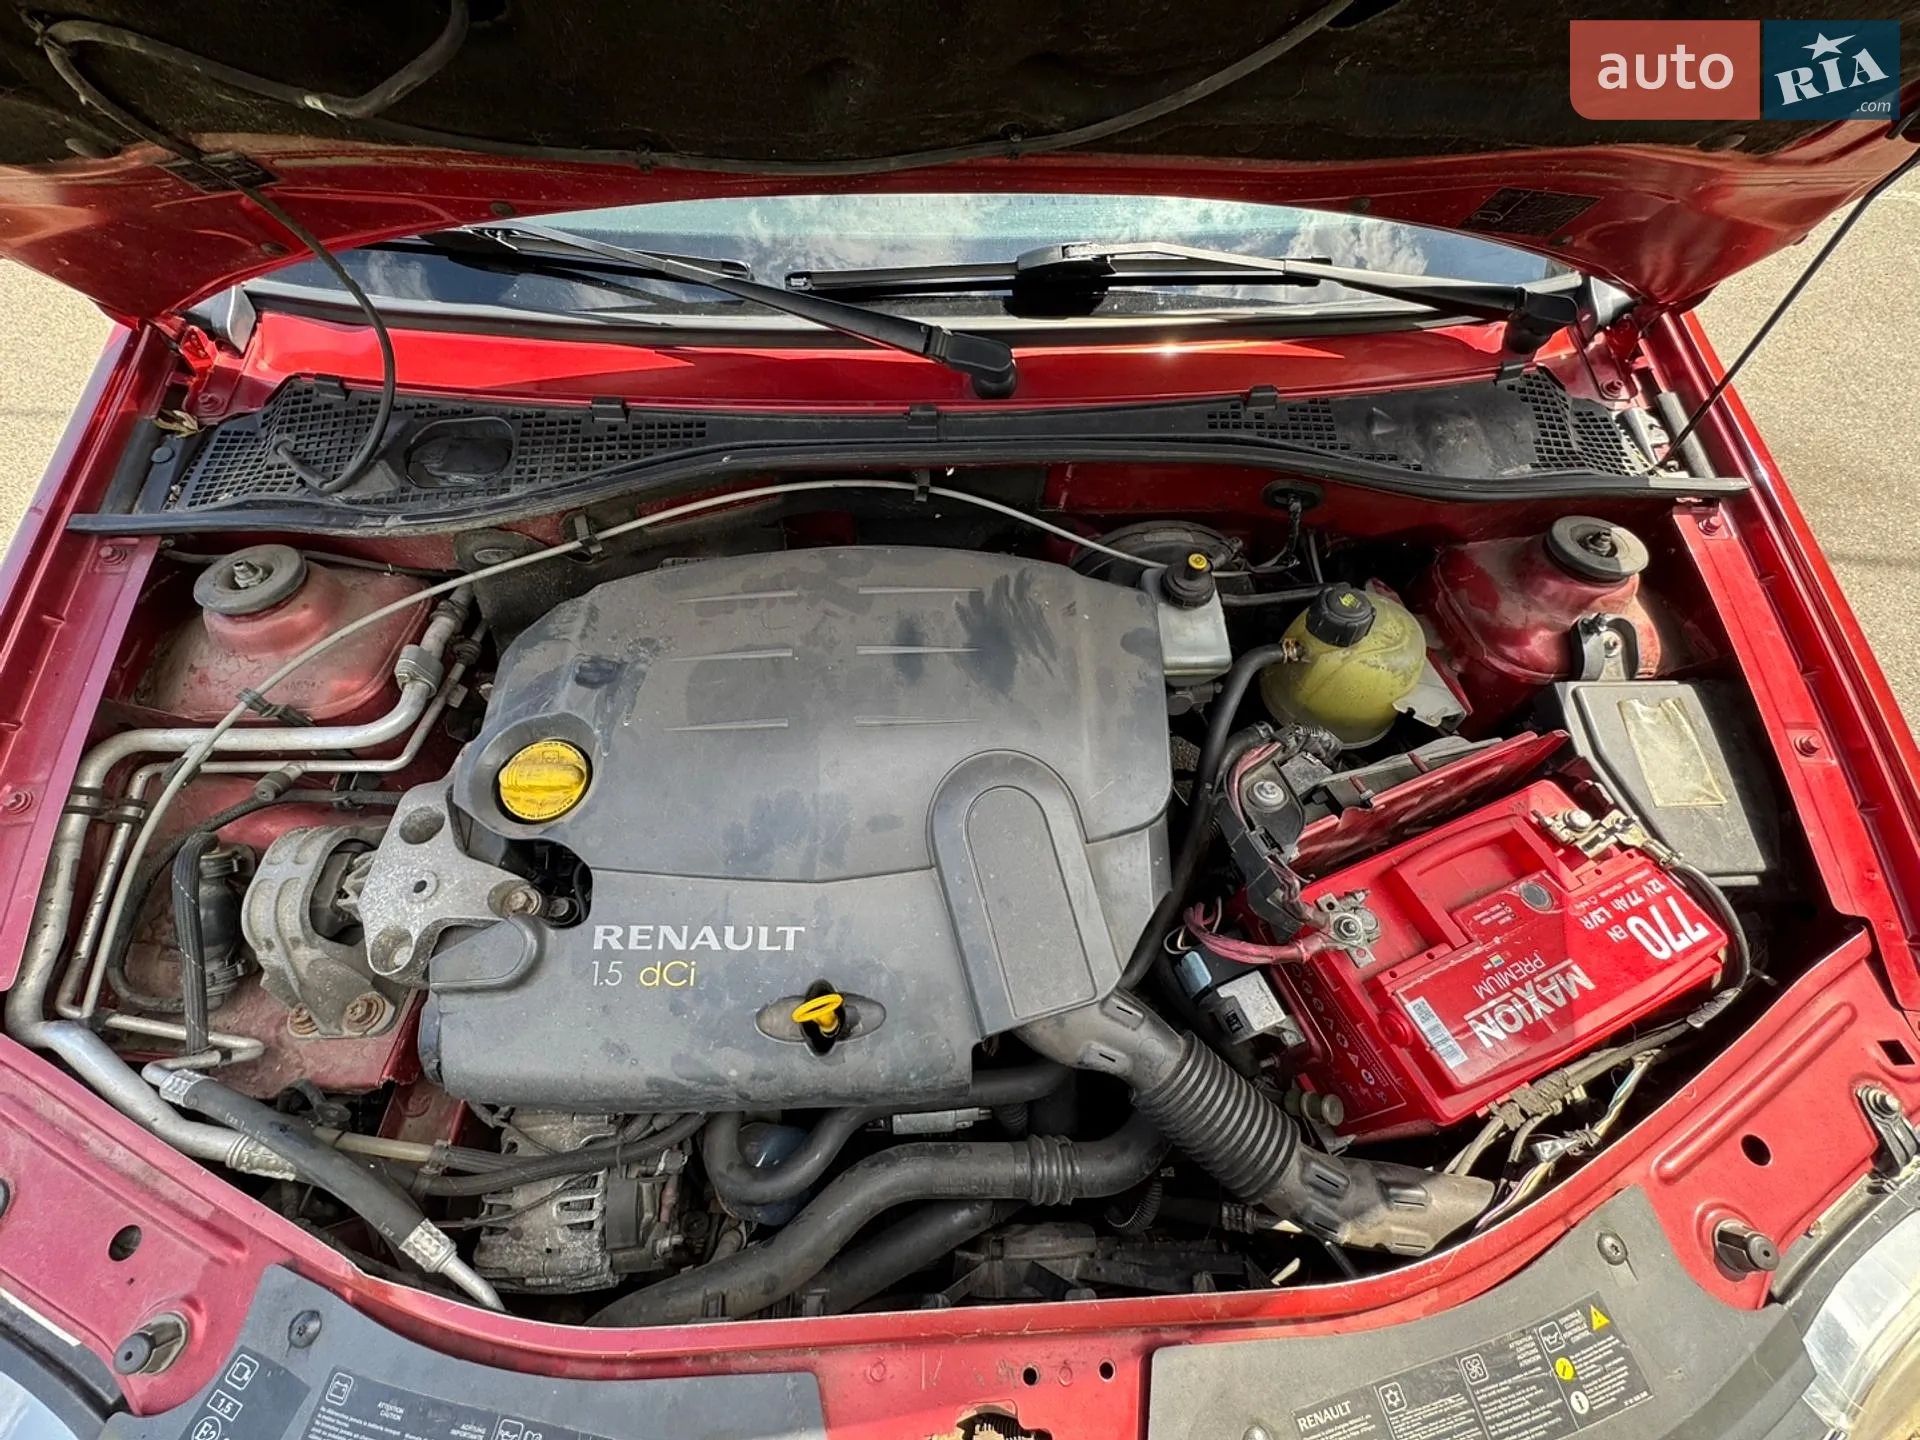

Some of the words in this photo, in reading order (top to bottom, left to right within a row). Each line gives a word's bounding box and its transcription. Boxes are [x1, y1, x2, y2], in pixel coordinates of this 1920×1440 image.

[1644, 878, 1667, 896] 12V
[593, 924, 806, 951] RENAULT
[1607, 924, 1629, 943] EN
[1626, 896, 1710, 960] 770
[591, 960, 624, 987] 1.5
[640, 960, 697, 987] dCi
[1472, 951, 1546, 999] PREMIUM
[1467, 963, 1596, 1049] MAXION
[1297, 1400, 1352, 1432] RENAULT
